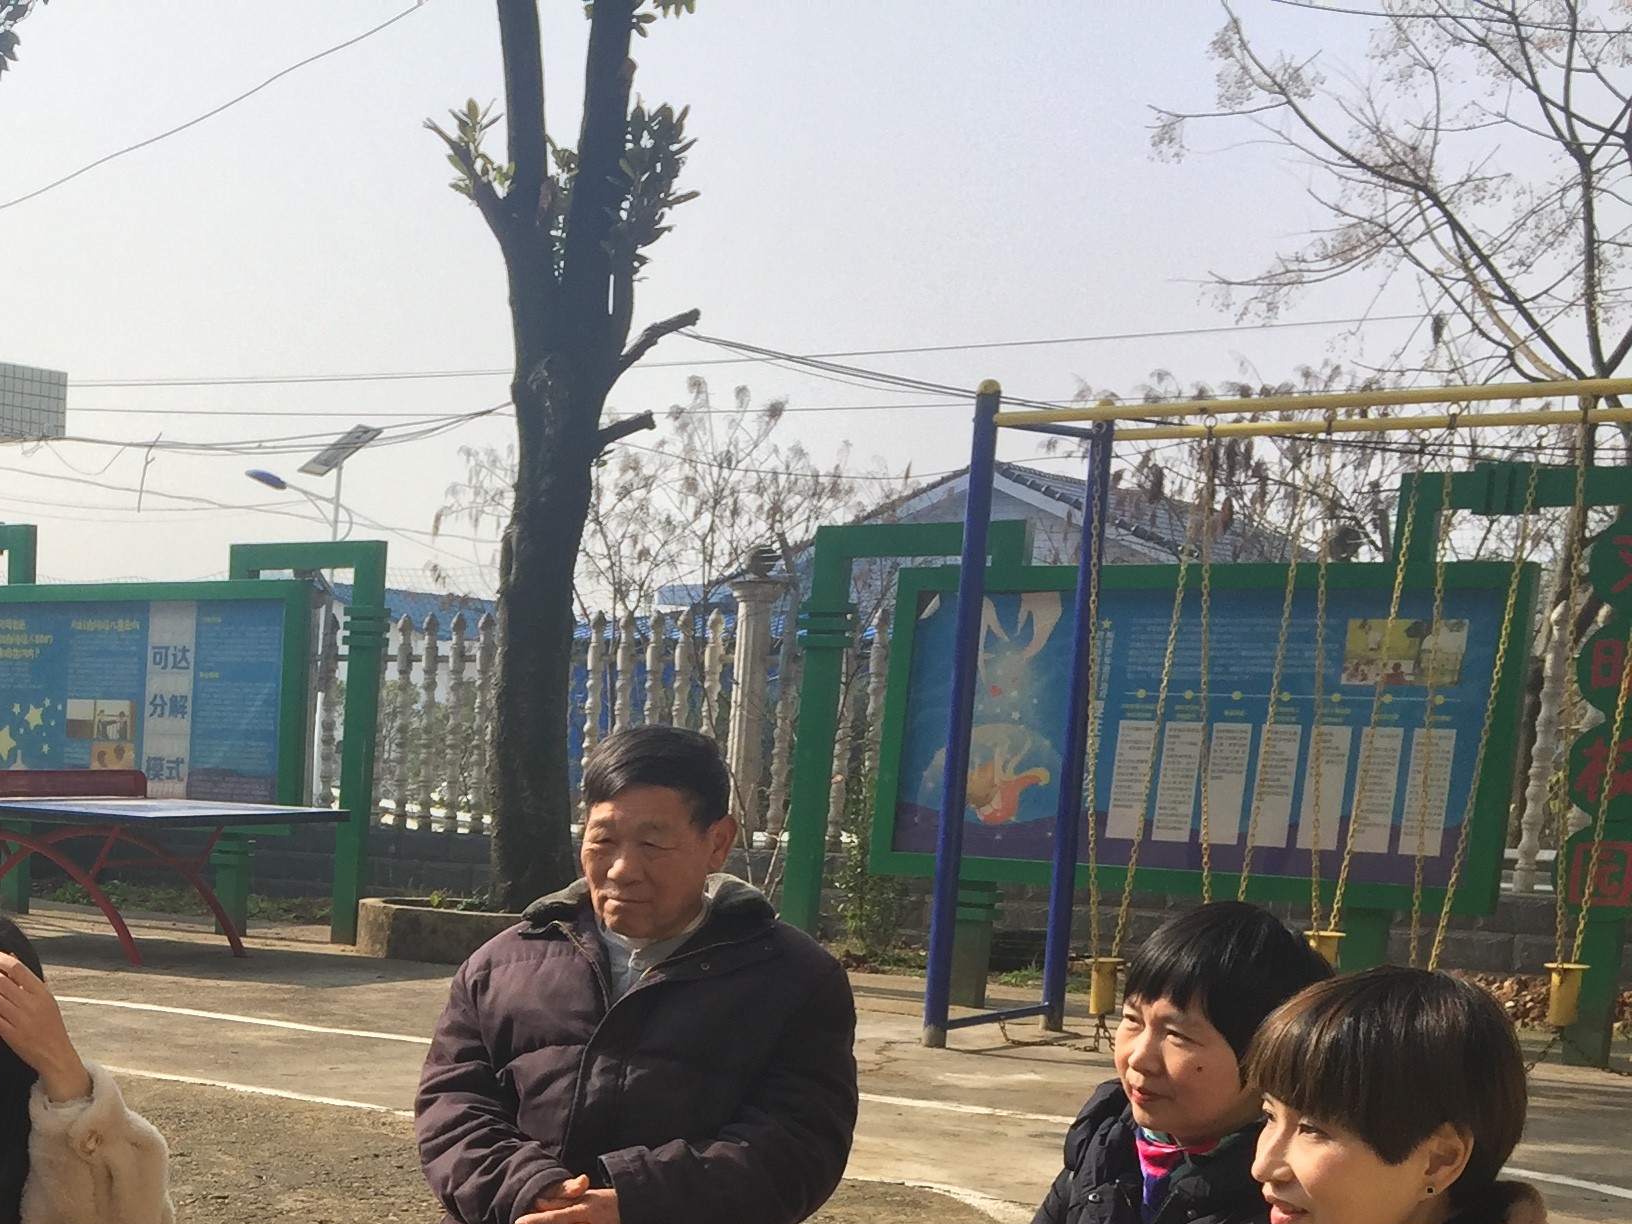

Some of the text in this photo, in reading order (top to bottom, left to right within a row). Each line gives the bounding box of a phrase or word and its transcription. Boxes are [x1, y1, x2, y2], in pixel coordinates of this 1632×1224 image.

[151, 645, 190, 670] 可达
[149, 693, 188, 719] 分解
[145, 755, 184, 782] 模式
